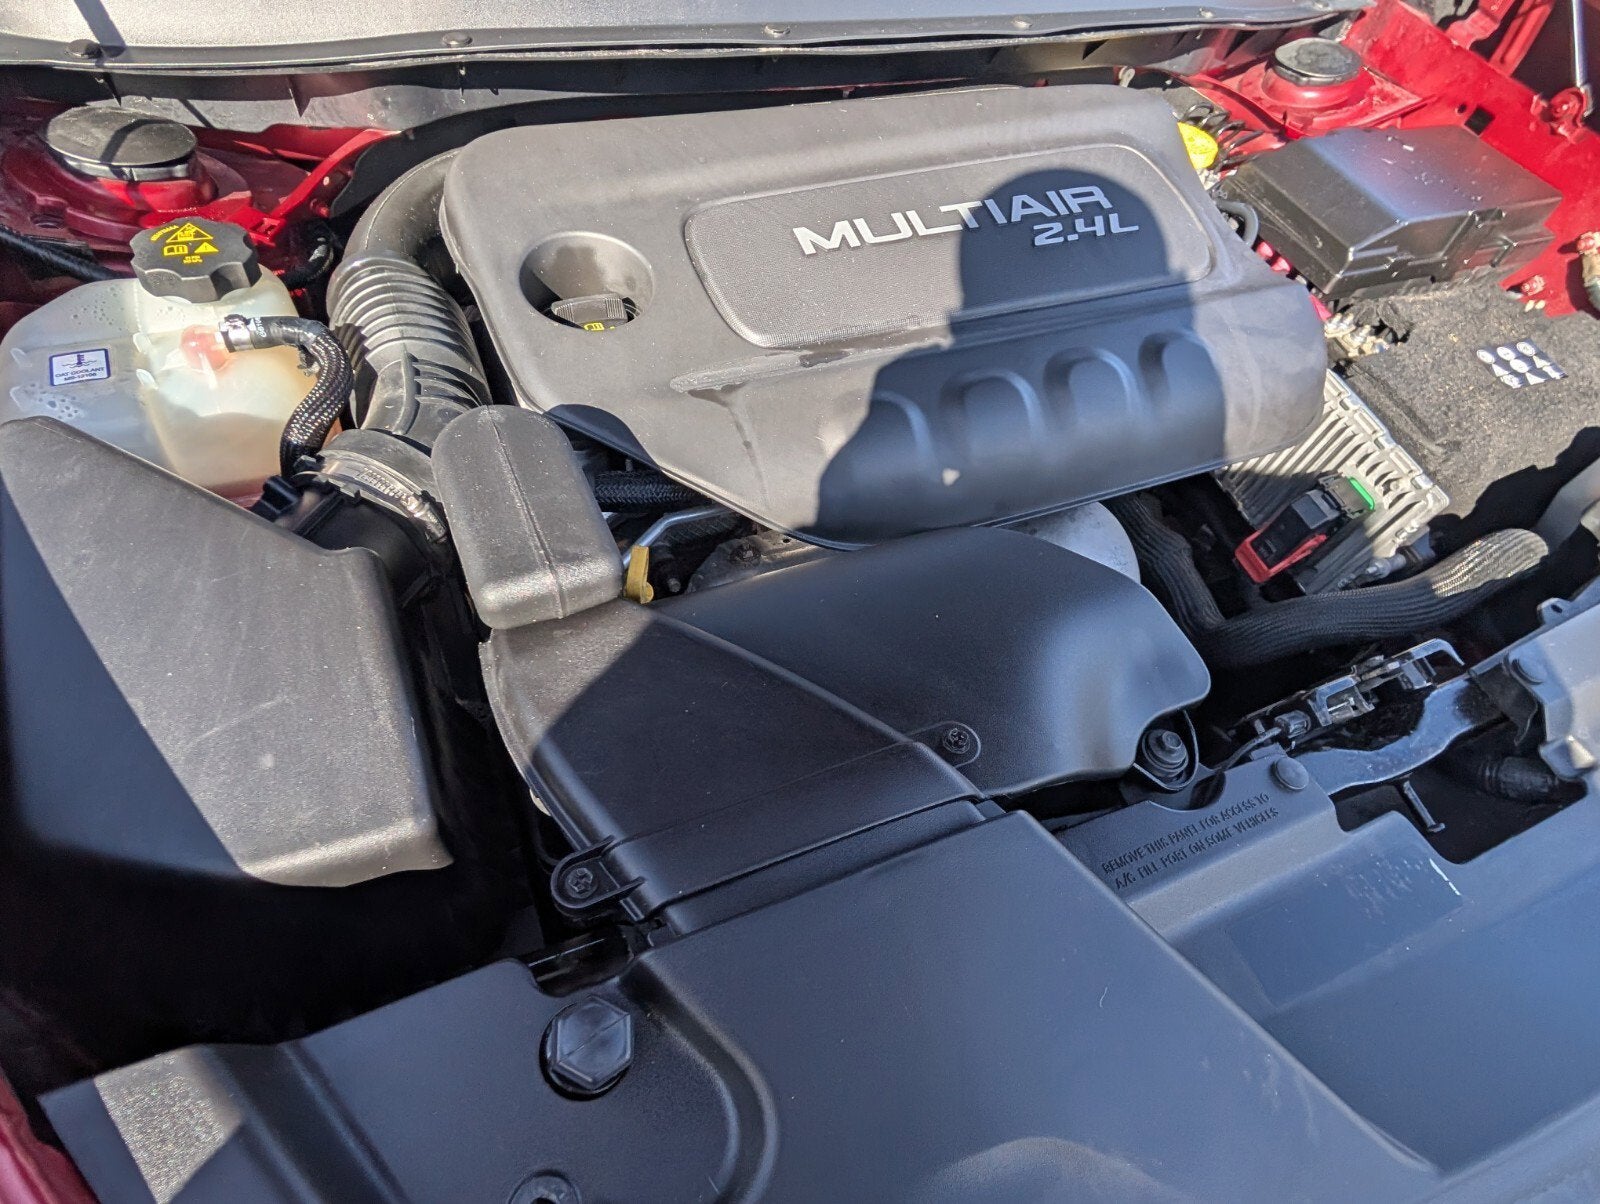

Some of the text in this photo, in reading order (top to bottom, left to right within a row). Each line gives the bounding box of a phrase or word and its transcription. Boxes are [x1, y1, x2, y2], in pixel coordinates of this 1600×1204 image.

[791, 185, 1114, 256] MULTIAIR
[1031, 212, 1140, 247] 2.4L
[1101, 792, 1270, 874] REMOVE THIS PANEL FOR ACCESS TO
[1115, 806, 1279, 890] A/C FILL PORT ON SOME VEHICLES
